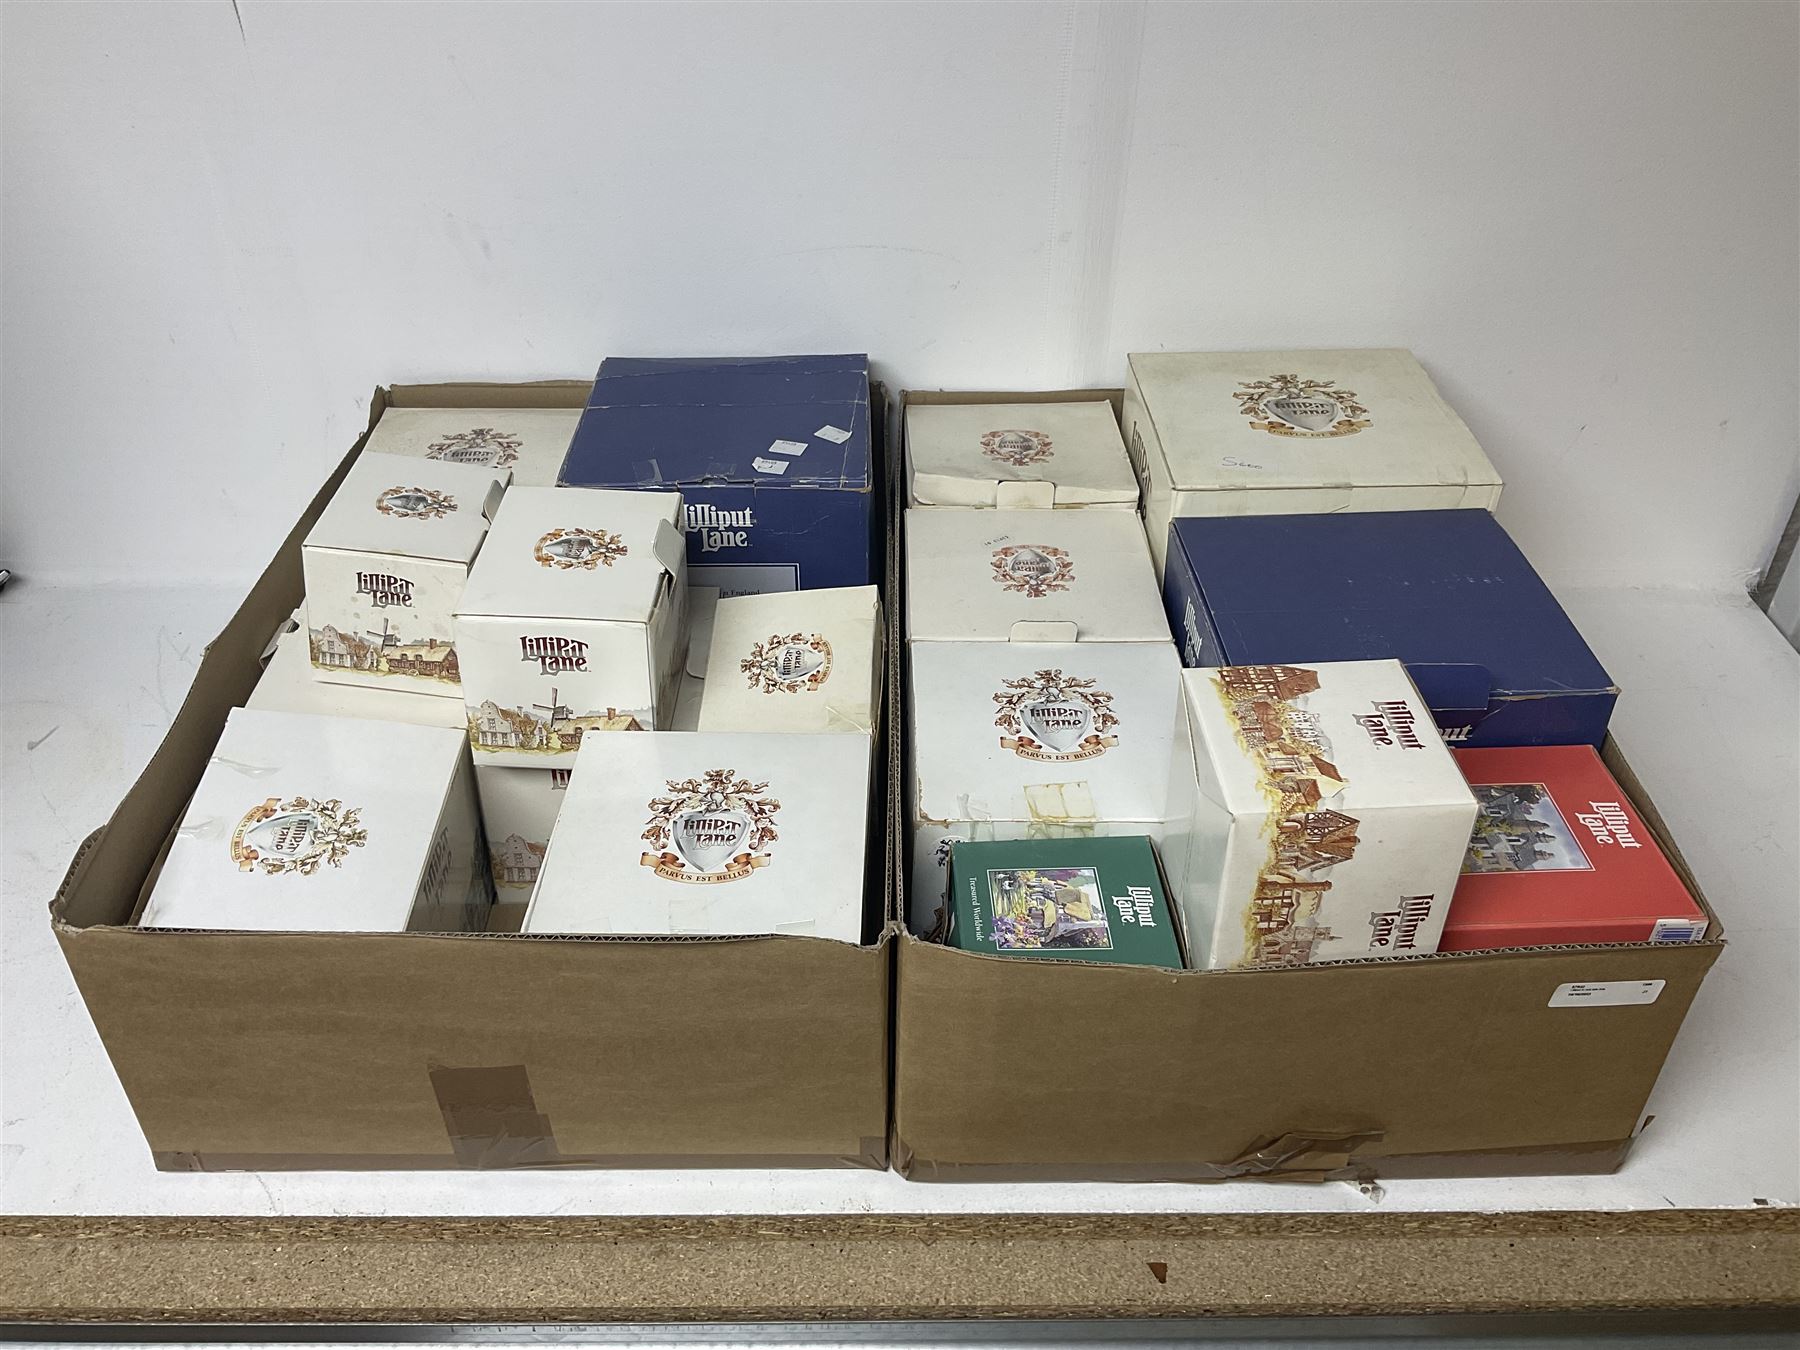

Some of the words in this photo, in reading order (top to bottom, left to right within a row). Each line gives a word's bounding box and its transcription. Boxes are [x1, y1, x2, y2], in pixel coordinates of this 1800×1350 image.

[701, 527, 749, 552] Lane
[371, 590, 413, 608] Lane
[538, 655, 588, 677] Lane
[1352, 713, 1393, 745] Lane
[1371, 700, 1426, 750] Lilliput
[1020, 749, 1052, 760] PARVUS
[1073, 747, 1103, 759] BELLUS
[1574, 812, 1614, 844] Lane
[1589, 800, 1643, 849] Lilliput
[692, 832, 738, 850] Lane
[658, 867, 693, 880] PARVUS
[715, 868, 750, 881] BELLUS
[968, 876, 978, 905] Treasured
[973, 905, 985, 942] Worldwide
[1111, 896, 1136, 923] Lane
[1126, 886, 1157, 927] Lilliput
[1392, 894, 1434, 951] Lilliput
[1368, 910, 1402, 948] Lane
